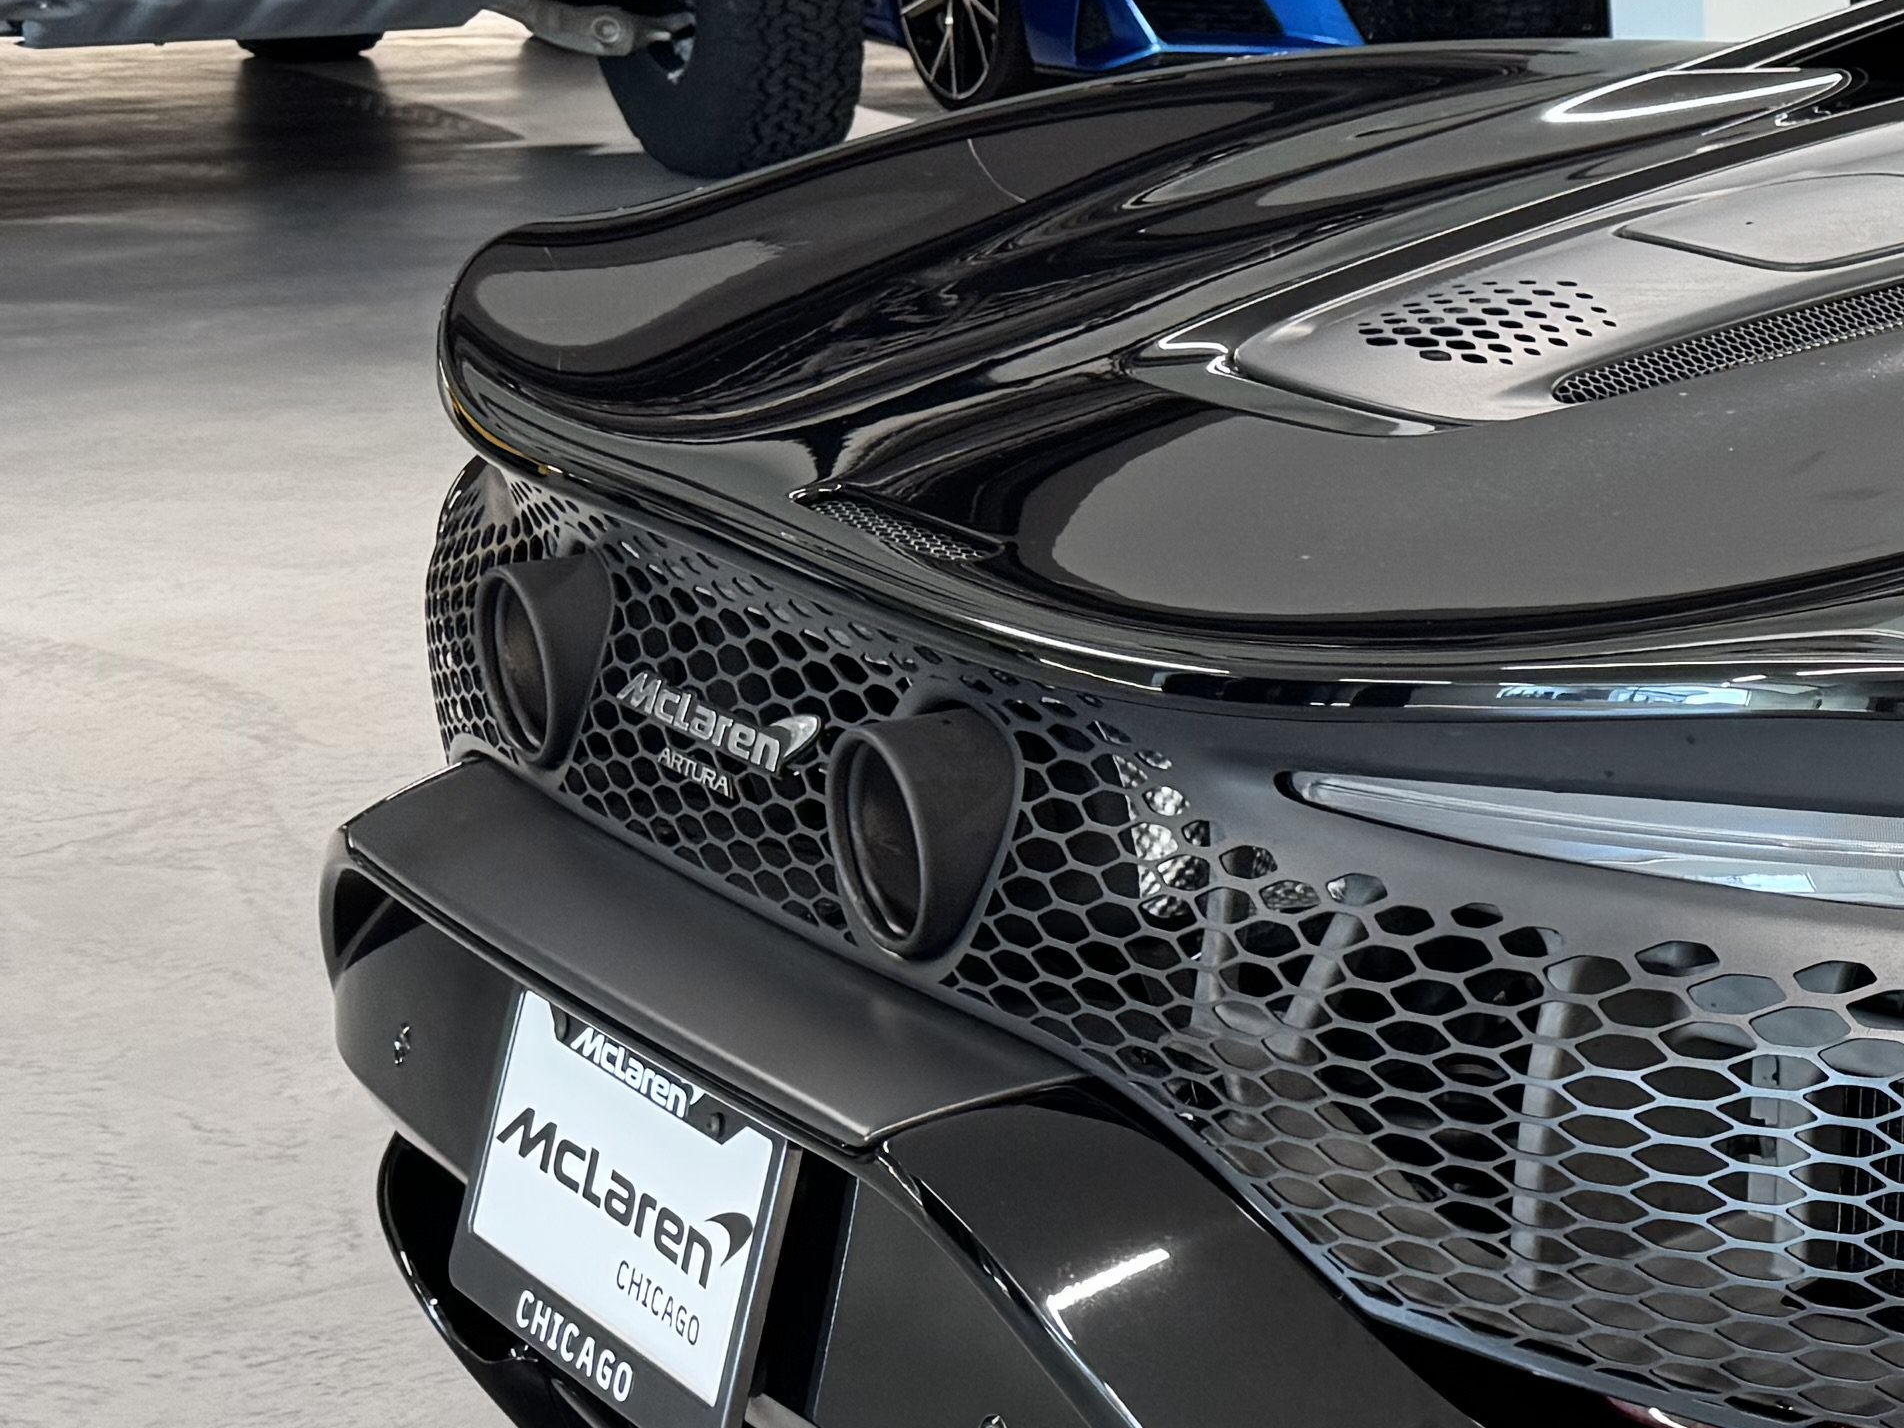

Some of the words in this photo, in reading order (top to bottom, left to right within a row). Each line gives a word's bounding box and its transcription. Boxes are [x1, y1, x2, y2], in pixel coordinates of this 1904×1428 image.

[616, 671, 781, 773] McLaren
[657, 747, 733, 798] ARTURA
[570, 1026, 691, 1118] McLaren
[496, 1107, 713, 1290] McLaren
[515, 1289, 635, 1403] CHICAGO
[616, 1259, 700, 1347] CHICAGO
